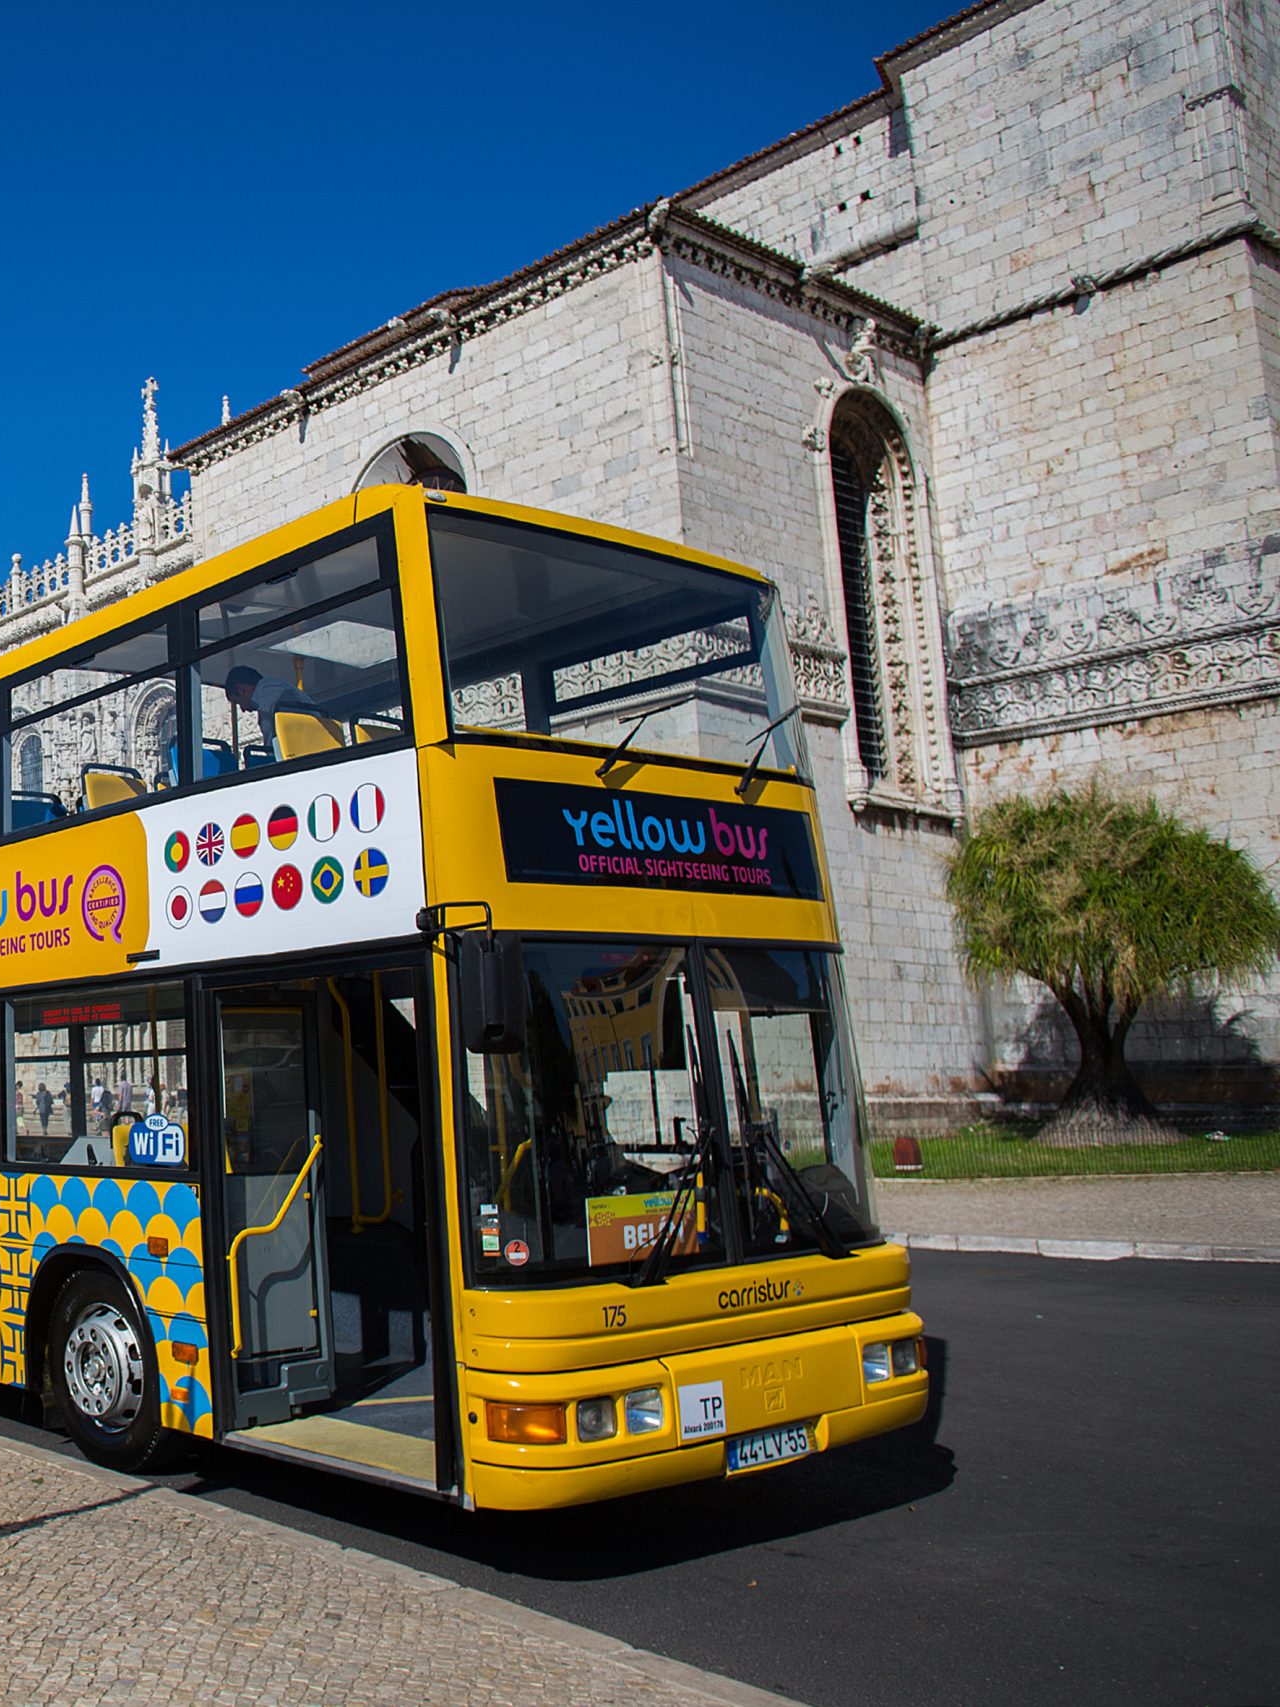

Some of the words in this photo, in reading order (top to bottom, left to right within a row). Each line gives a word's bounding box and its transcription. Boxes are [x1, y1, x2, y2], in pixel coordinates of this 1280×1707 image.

[708, 807, 769, 861] bus
[578, 854, 642, 876] OFFICIAL
[645, 858, 730, 883] SIGHTSEEING
[731, 865, 772, 886] TOURS
[15, 870, 74, 922] bus
[88, 876, 117, 899] EXCELLENCE
[87, 897, 119, 910] CERTIFIED
[29, 927, 71, 952] TOURS
[149, 1118, 164, 1128] FREE
[513, 1241, 521, 1253] 2
[717, 1276, 791, 1310] carristur
[602, 1304, 627, 1328] 175
[740, 1357, 803, 1389] MAN
[699, 1396, 723, 1420] TP
